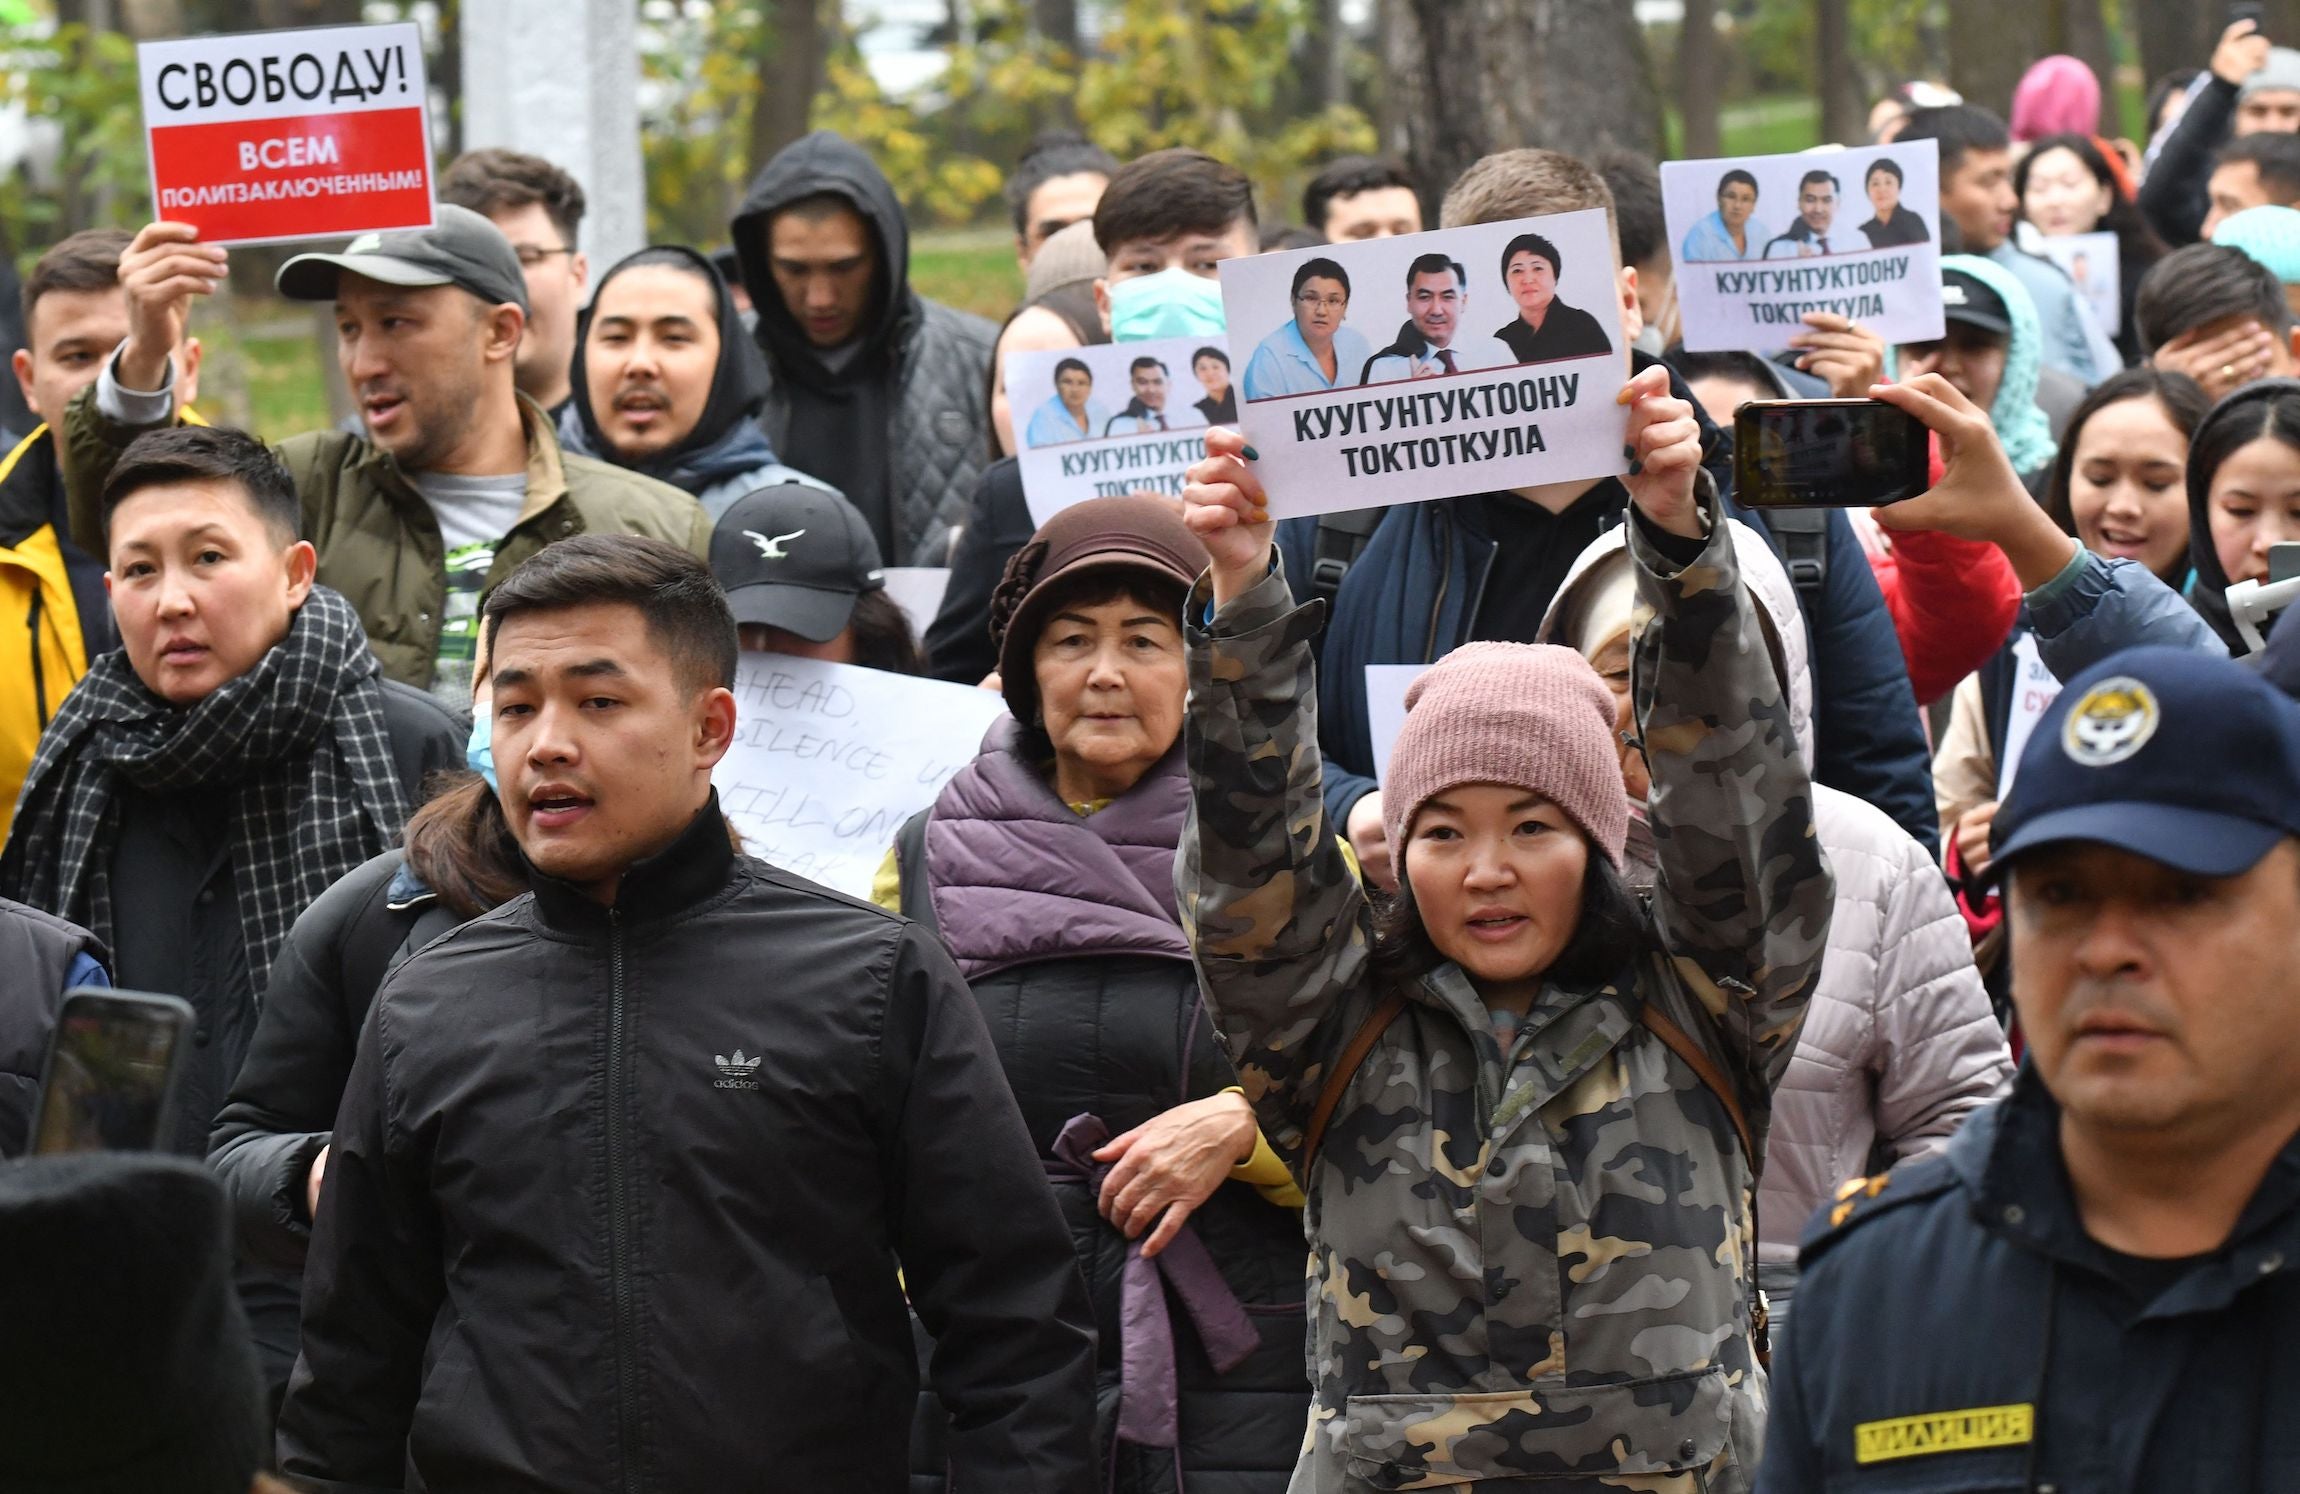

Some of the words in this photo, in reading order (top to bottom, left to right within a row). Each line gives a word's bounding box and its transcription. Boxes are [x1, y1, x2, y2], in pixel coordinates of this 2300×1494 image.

[158, 45, 408, 111] СВОБОДУ!
[238, 135, 339, 171] ВСЕМ
[161, 169, 423, 208] ПОЛИТЗАКЛЮЧЕННЫМ!
[1716, 256, 1910, 294] КУУГУНТУКТООНУ
[1293, 373, 1579, 442] КУУГУНТУКТООНУ
[1341, 424, 1546, 477] ТОКТОТКУЛА
[713, 1079, 759, 1091] adidas
